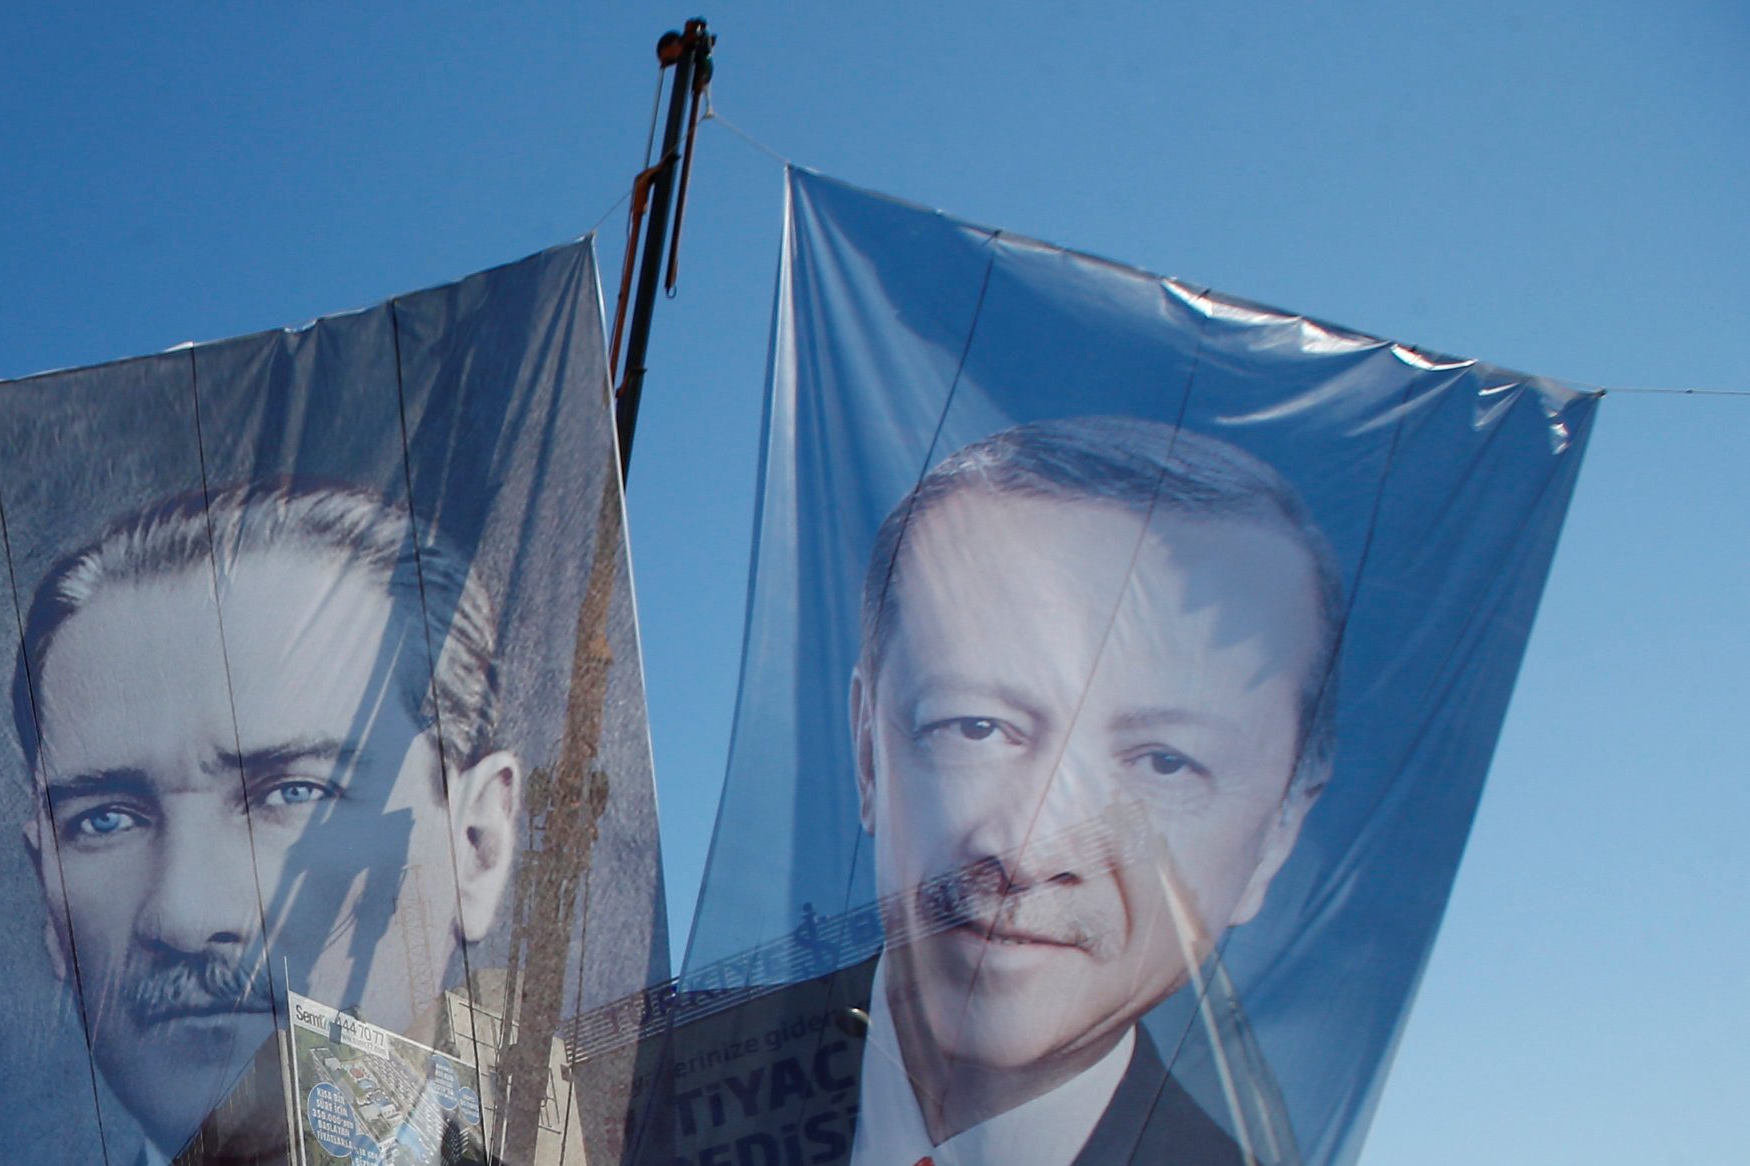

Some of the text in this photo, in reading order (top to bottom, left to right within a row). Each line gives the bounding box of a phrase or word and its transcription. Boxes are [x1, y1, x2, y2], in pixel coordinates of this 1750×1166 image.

[358, 1022, 372, 1041] 70
[372, 1028, 385, 1045] 77
[672, 1038, 857, 1137] TİYAÇ
